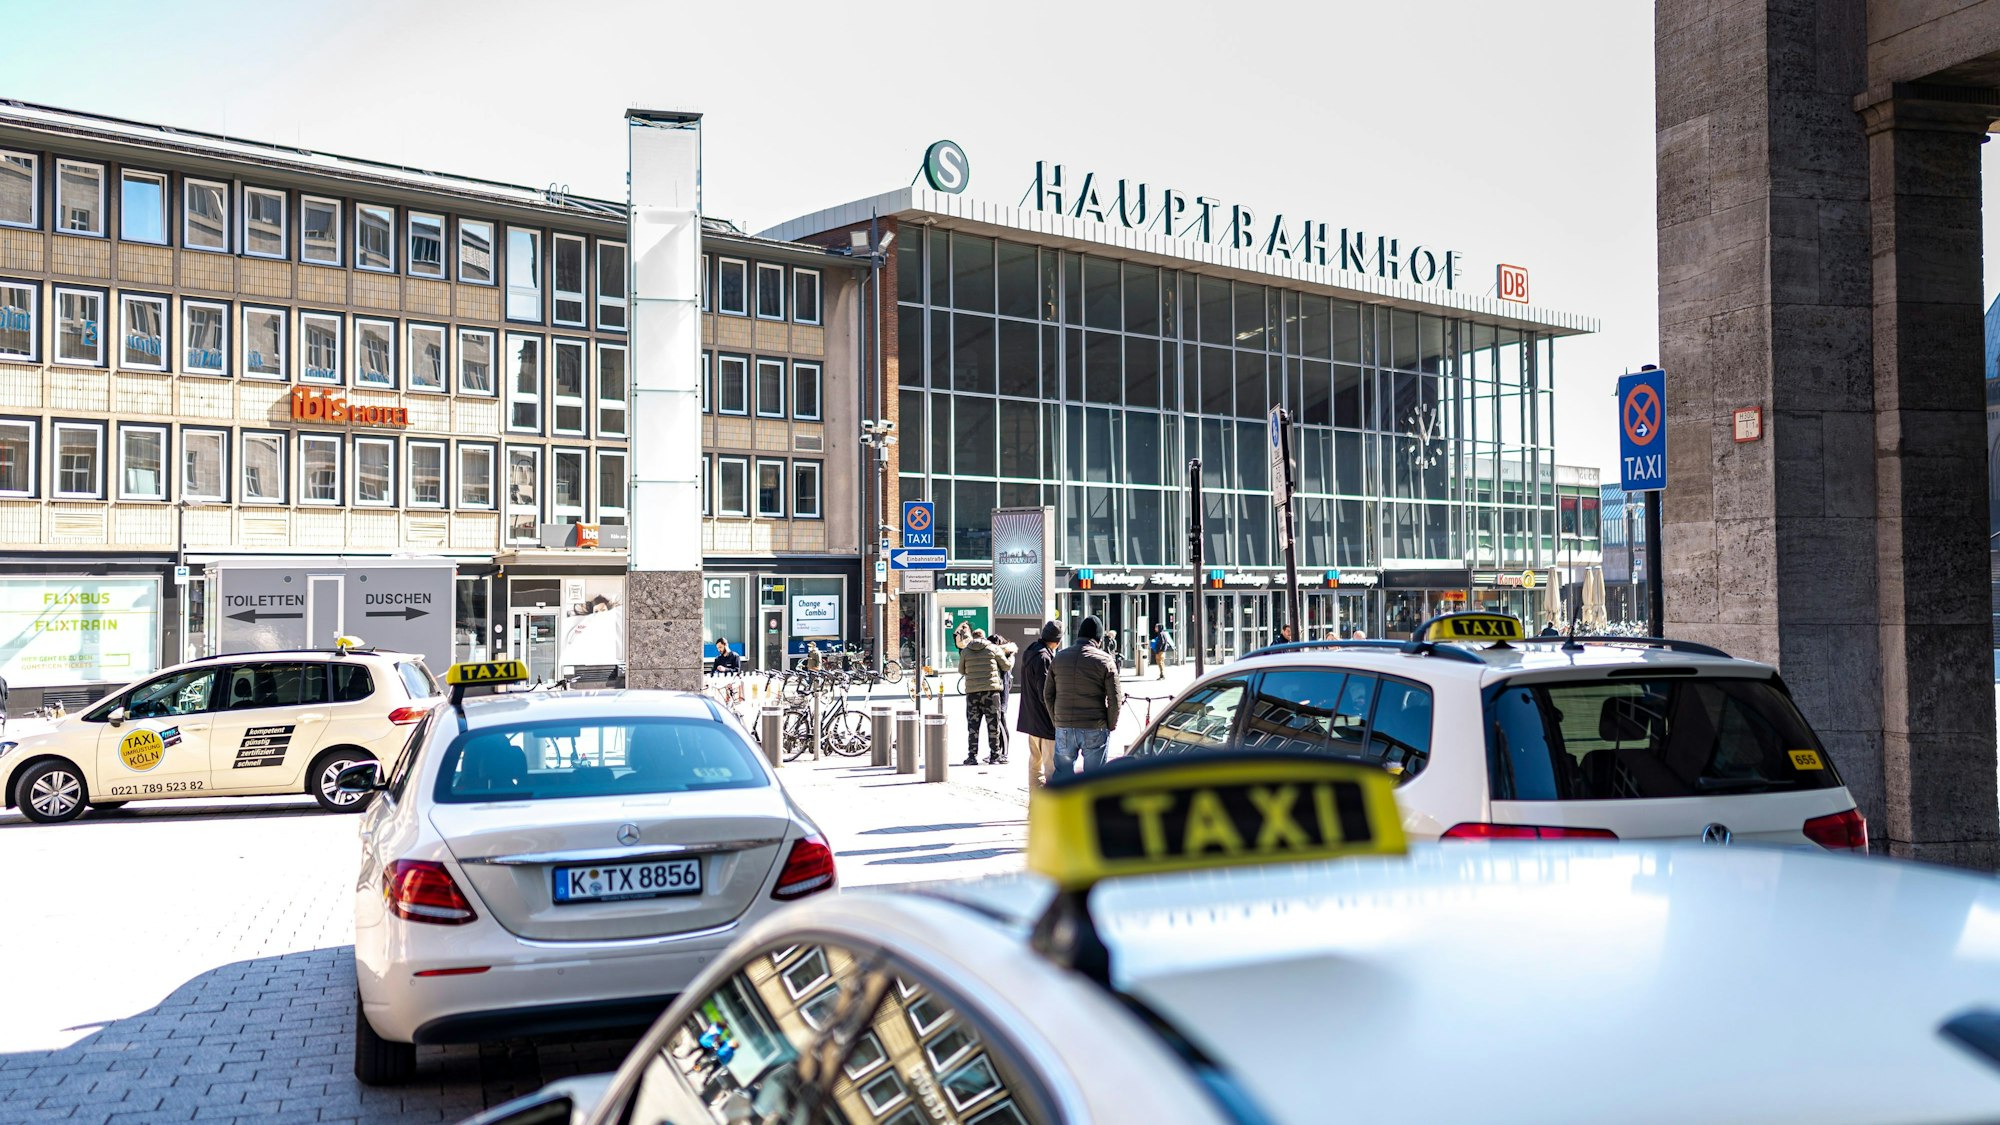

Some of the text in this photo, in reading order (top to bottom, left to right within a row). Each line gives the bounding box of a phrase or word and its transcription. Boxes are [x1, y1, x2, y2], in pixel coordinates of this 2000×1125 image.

[937, 147, 962, 188] S
[1036, 160, 1462, 290] HAUPTBAHNHOF
[1503, 270, 1525, 298] DB
[291, 387, 414, 426] ibis HOTEL
[1624, 454, 1662, 480] TAXI
[582, 528, 598, 540] ibis
[906, 534, 931, 544] TAXI
[944, 573, 967, 586] THE
[1498, 574, 1522, 588] Kamps
[225, 594, 304, 607] TOILETTEN
[365, 593, 432, 605] DUSCHEN
[798, 600, 820, 609] Change
[1459, 620, 1508, 636] TAXI
[463, 663, 515, 680] TAXI
[249, 727, 285, 735] kompetent
[125, 733, 155, 748] TAXI
[244, 738, 271, 747] günstig
[129, 751, 159, 766] KÖLN
[240, 748, 275, 757] zertifiziert
[237, 759, 263, 767] schnell
[1795, 755, 1816, 765] 655
[111, 780, 204, 796] 0221 789 523 82
[1121, 784, 1345, 859] TAXI
[571, 871, 586, 894] K
[603, 868, 633, 892] TX
[639, 863, 697, 889] 8856
